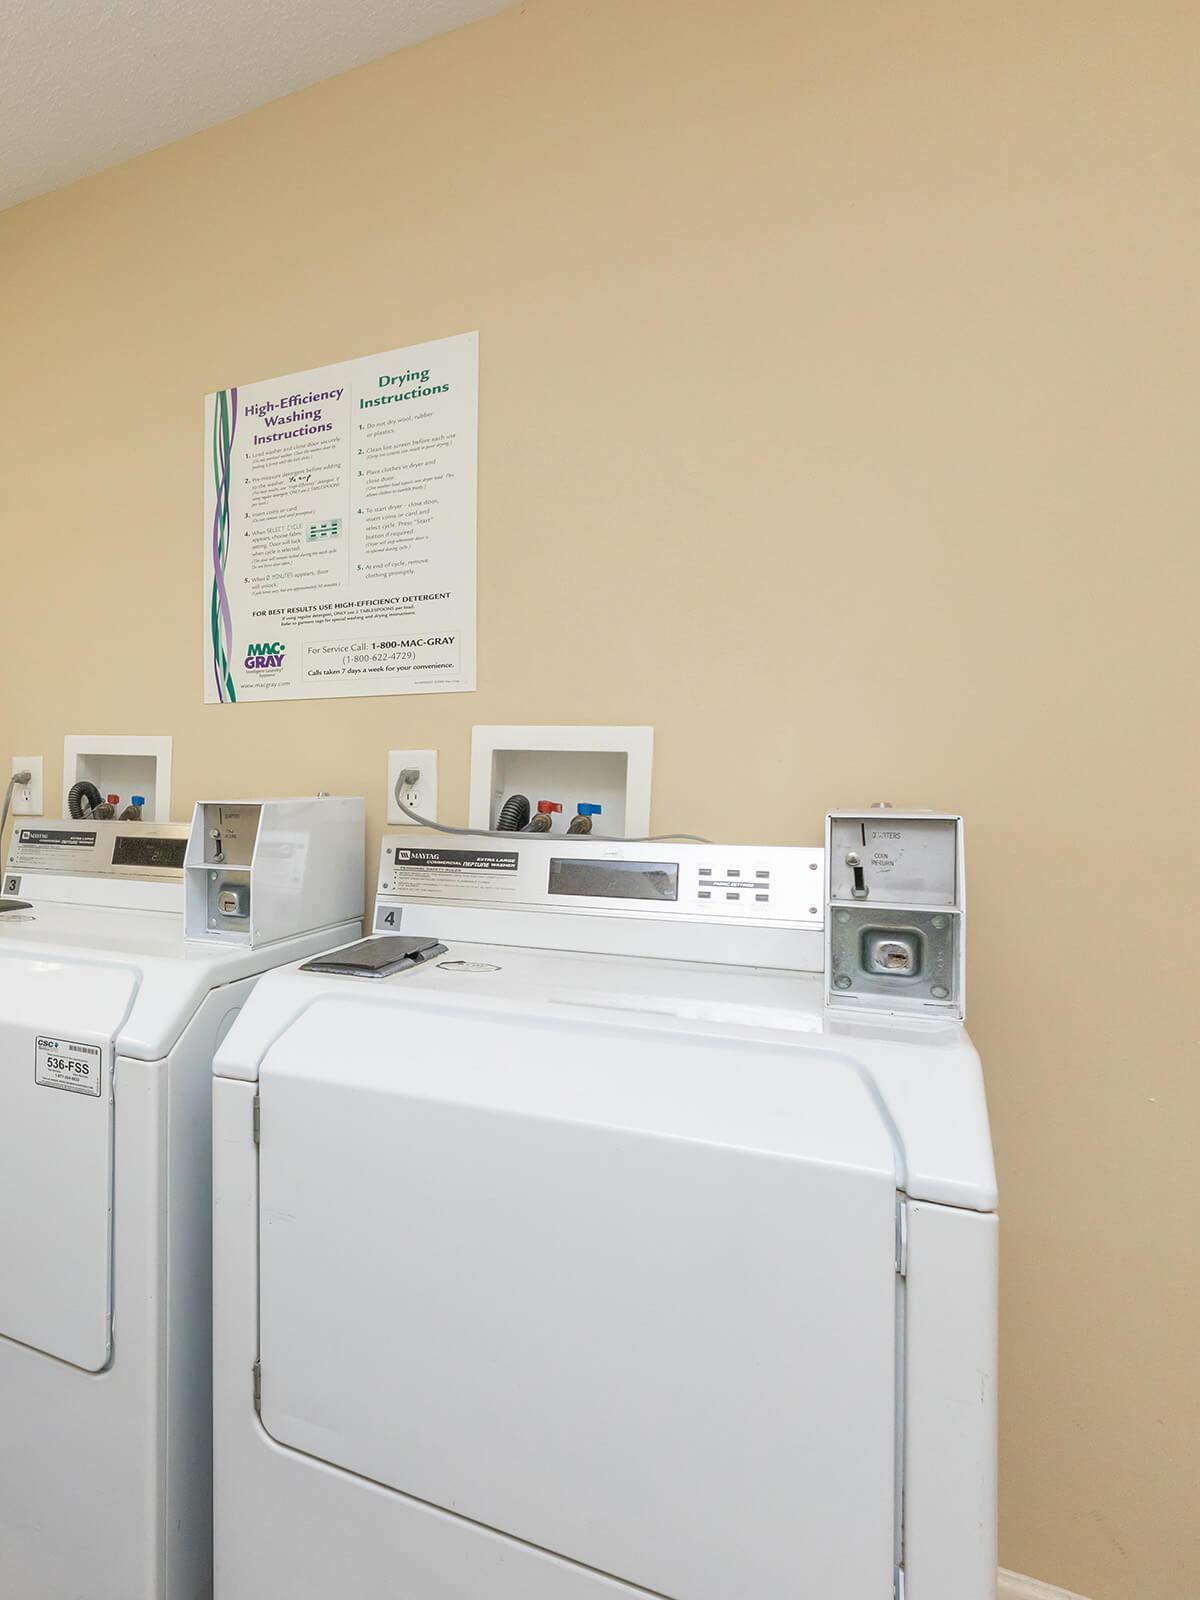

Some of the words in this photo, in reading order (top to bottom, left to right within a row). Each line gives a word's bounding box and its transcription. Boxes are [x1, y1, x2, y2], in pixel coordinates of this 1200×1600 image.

[378, 369, 430, 387] Drying
[245, 388, 344, 417] High-Efficiency
[360, 384, 449, 409] Instructions
[265, 409, 322, 427] Washing
[254, 423, 332, 445] Instructions
[286, 605, 316, 613] RESULTS
[334, 596, 399, 609] HIGH-EFFICIENCY
[402, 592, 450, 602] DETERGENT
[322, 643, 348, 653] Service
[350, 642, 368, 650] Call:
[372, 636, 454, 649] 1-800-MAC-GRAY
[244, 654, 284, 669] GRAY
[342, 650, 415, 665] (1-800-622-4729)
[347, 667, 360, 675] days
[412, 661, 454, 670] convenience.
[9, 879, 16, 891] 3
[384, 911, 395, 926] 4
[47, 1057, 89, 1075] 536-FSS
